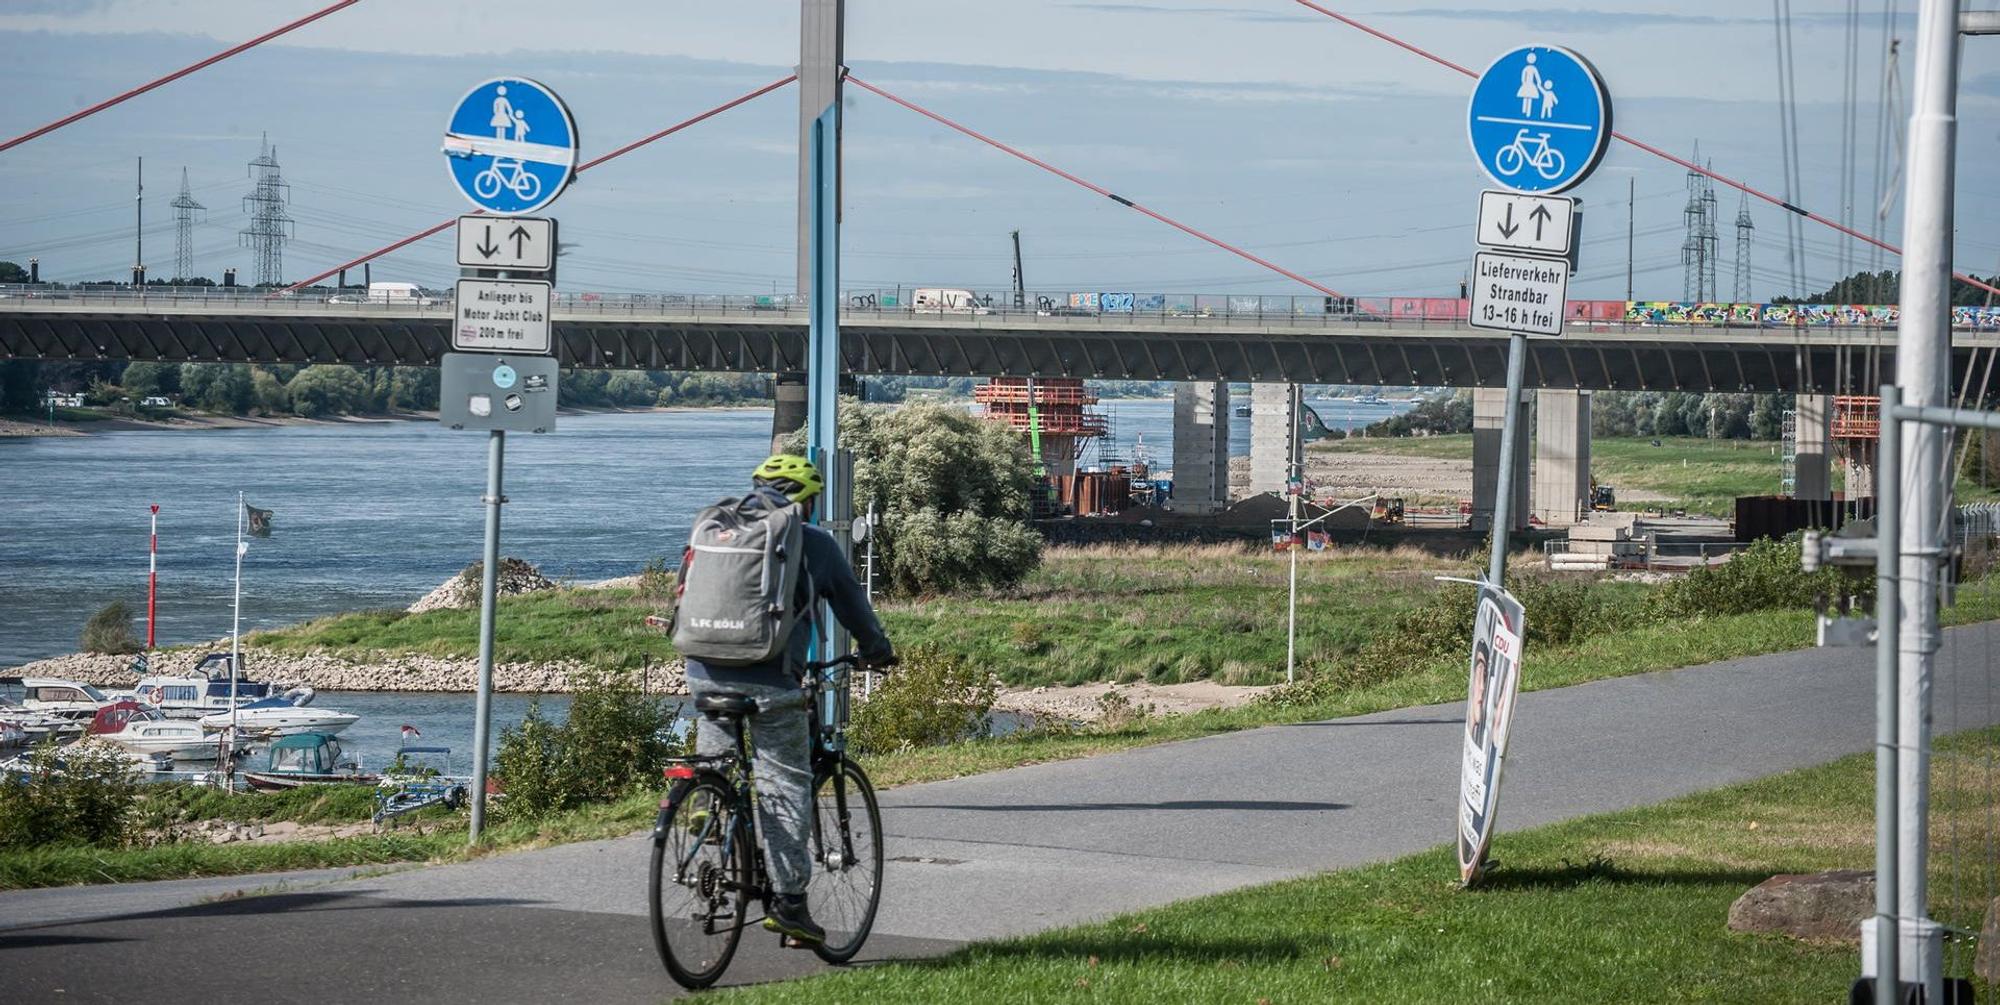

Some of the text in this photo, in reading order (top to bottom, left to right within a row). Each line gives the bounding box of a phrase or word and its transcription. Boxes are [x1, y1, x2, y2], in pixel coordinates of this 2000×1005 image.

[1481, 261, 1560, 284] Lieferverkehr
[478, 290, 533, 305] Anlieger bis
[1490, 283, 1548, 305] Strandbar
[464, 308, 543, 322] Motor Jacht Club
[1521, 309, 1528, 325] h
[1532, 310, 1554, 328] frei
[479, 327, 495, 338] 200
[507, 329, 524, 340] frei
[699, 618, 712, 628] FC
[713, 617, 744, 630] KÖLN
[1495, 634, 1509, 654] CDU
